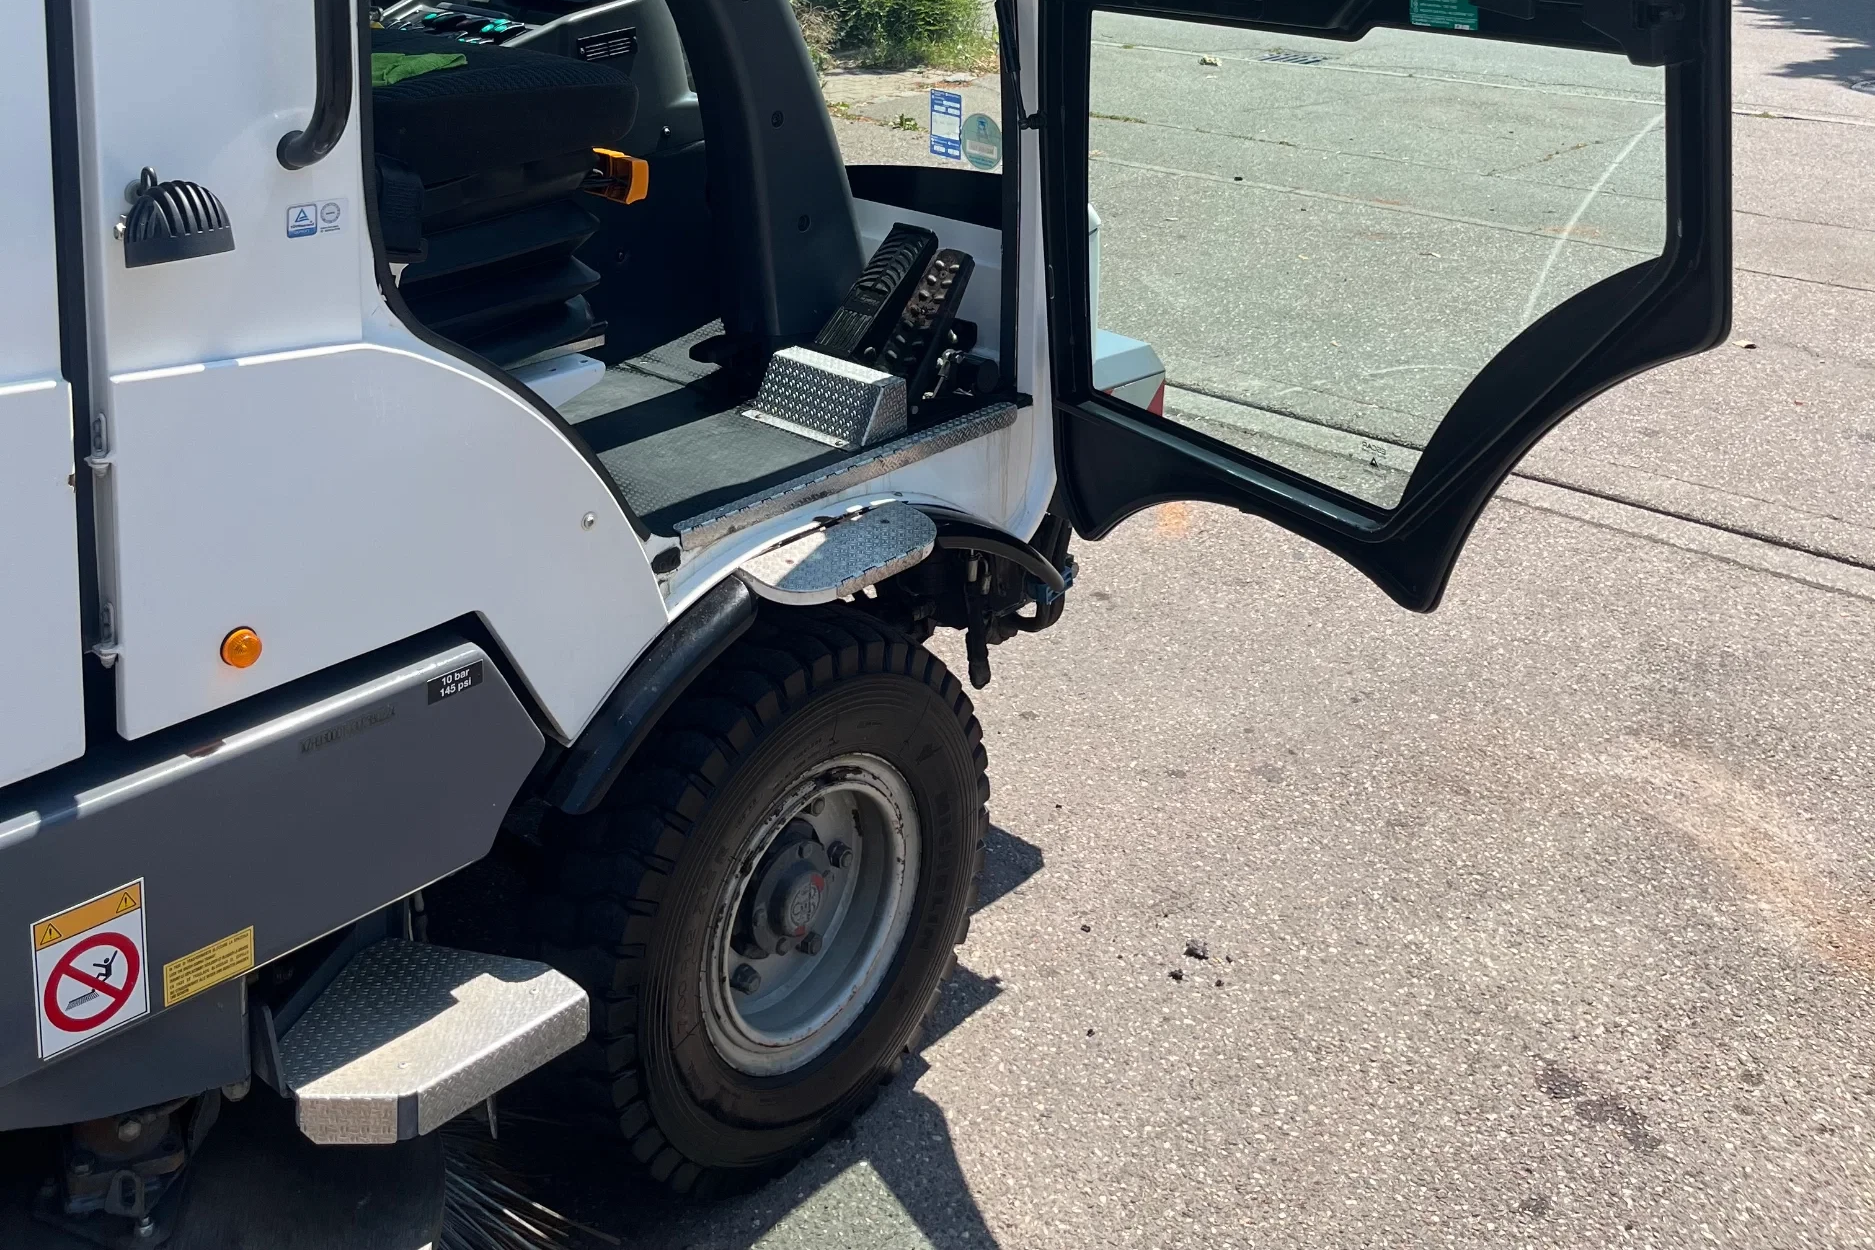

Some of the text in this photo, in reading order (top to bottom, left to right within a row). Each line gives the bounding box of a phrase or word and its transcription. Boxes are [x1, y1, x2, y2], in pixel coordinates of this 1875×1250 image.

[442, 669, 470, 685] 10 bar
[440, 677, 471, 697] 145 psi
